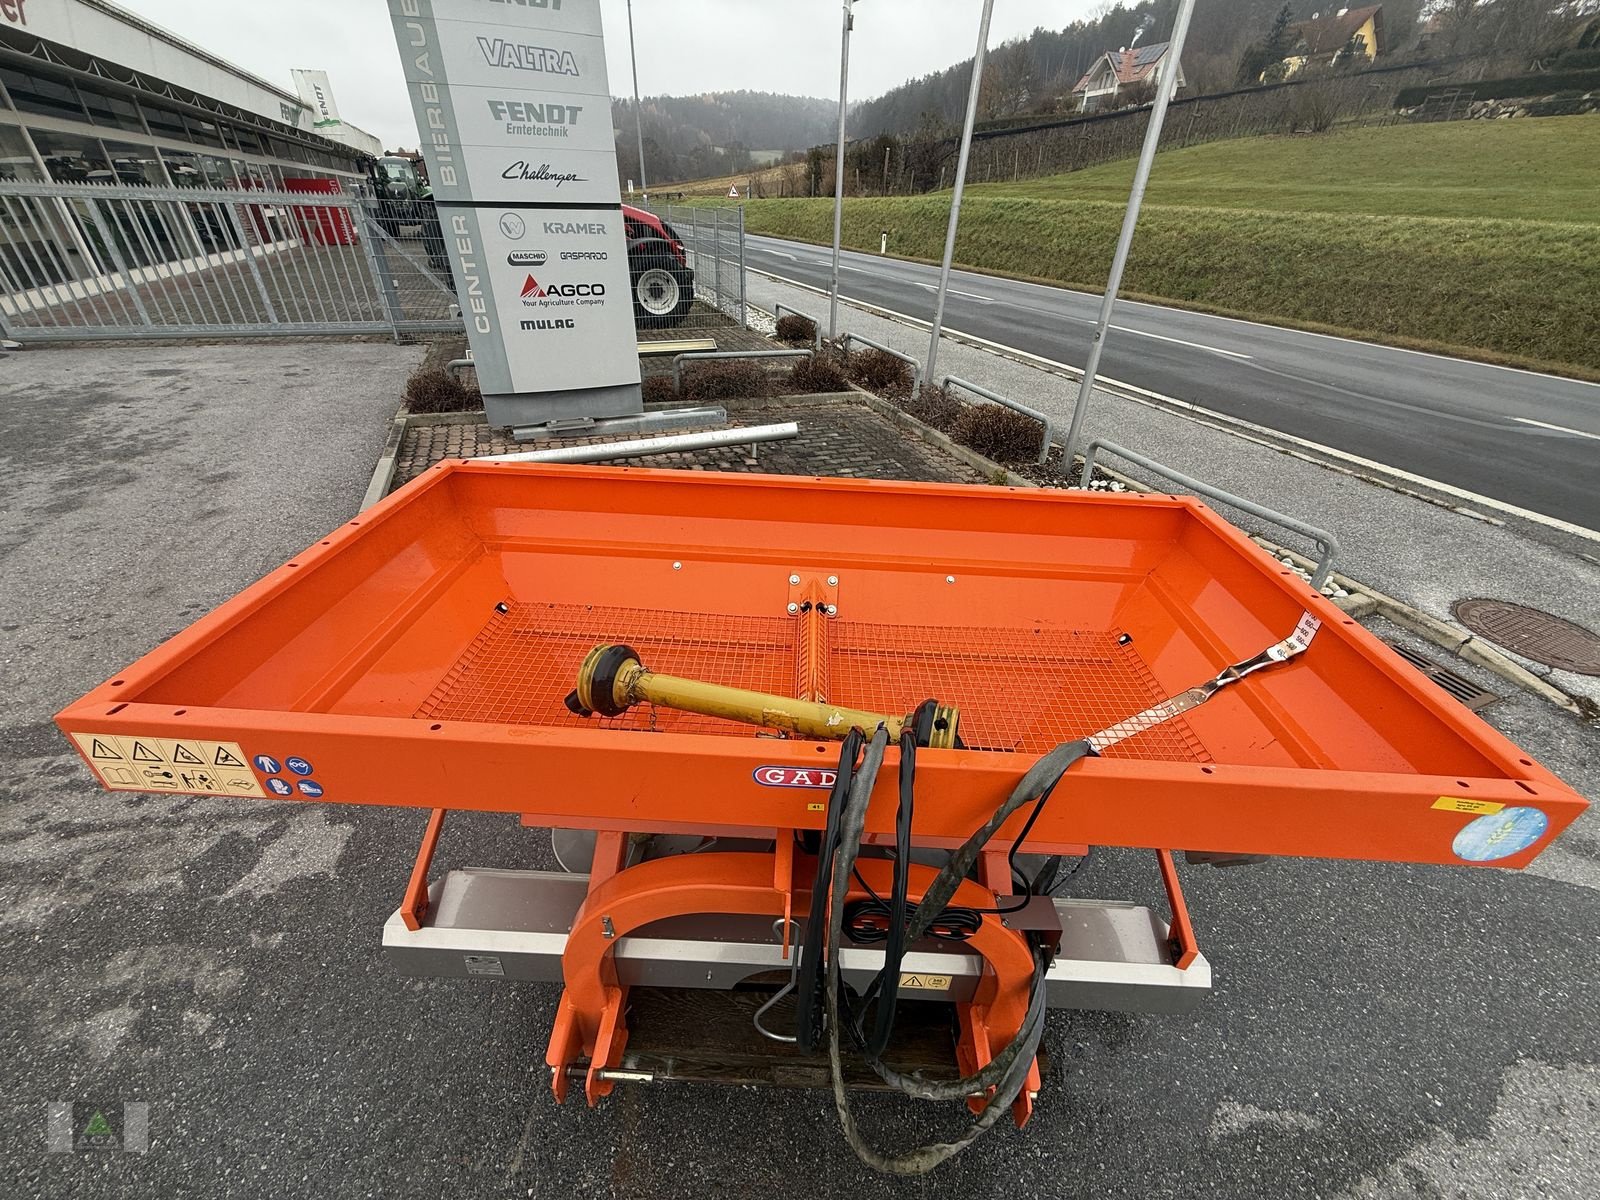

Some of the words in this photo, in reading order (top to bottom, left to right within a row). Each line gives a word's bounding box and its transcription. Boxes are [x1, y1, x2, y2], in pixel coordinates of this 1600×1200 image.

[476, 36, 580, 77] VALTRA
[487, 100, 583, 125] FENDT
[506, 122, 569, 138] Erntetechnik
[501, 160, 589, 187] Challenger
[543, 222, 607, 235] KRAMER
[512, 252, 546, 260] MASCHIO
[560, 252, 608, 260] GASPARDO
[452, 215, 491, 334] CENTER
[546, 284, 605, 297] AGCO
[539, 299, 575, 308] Agriculture
[576, 298, 605, 306] Company
[520, 319, 575, 330] MULAG
